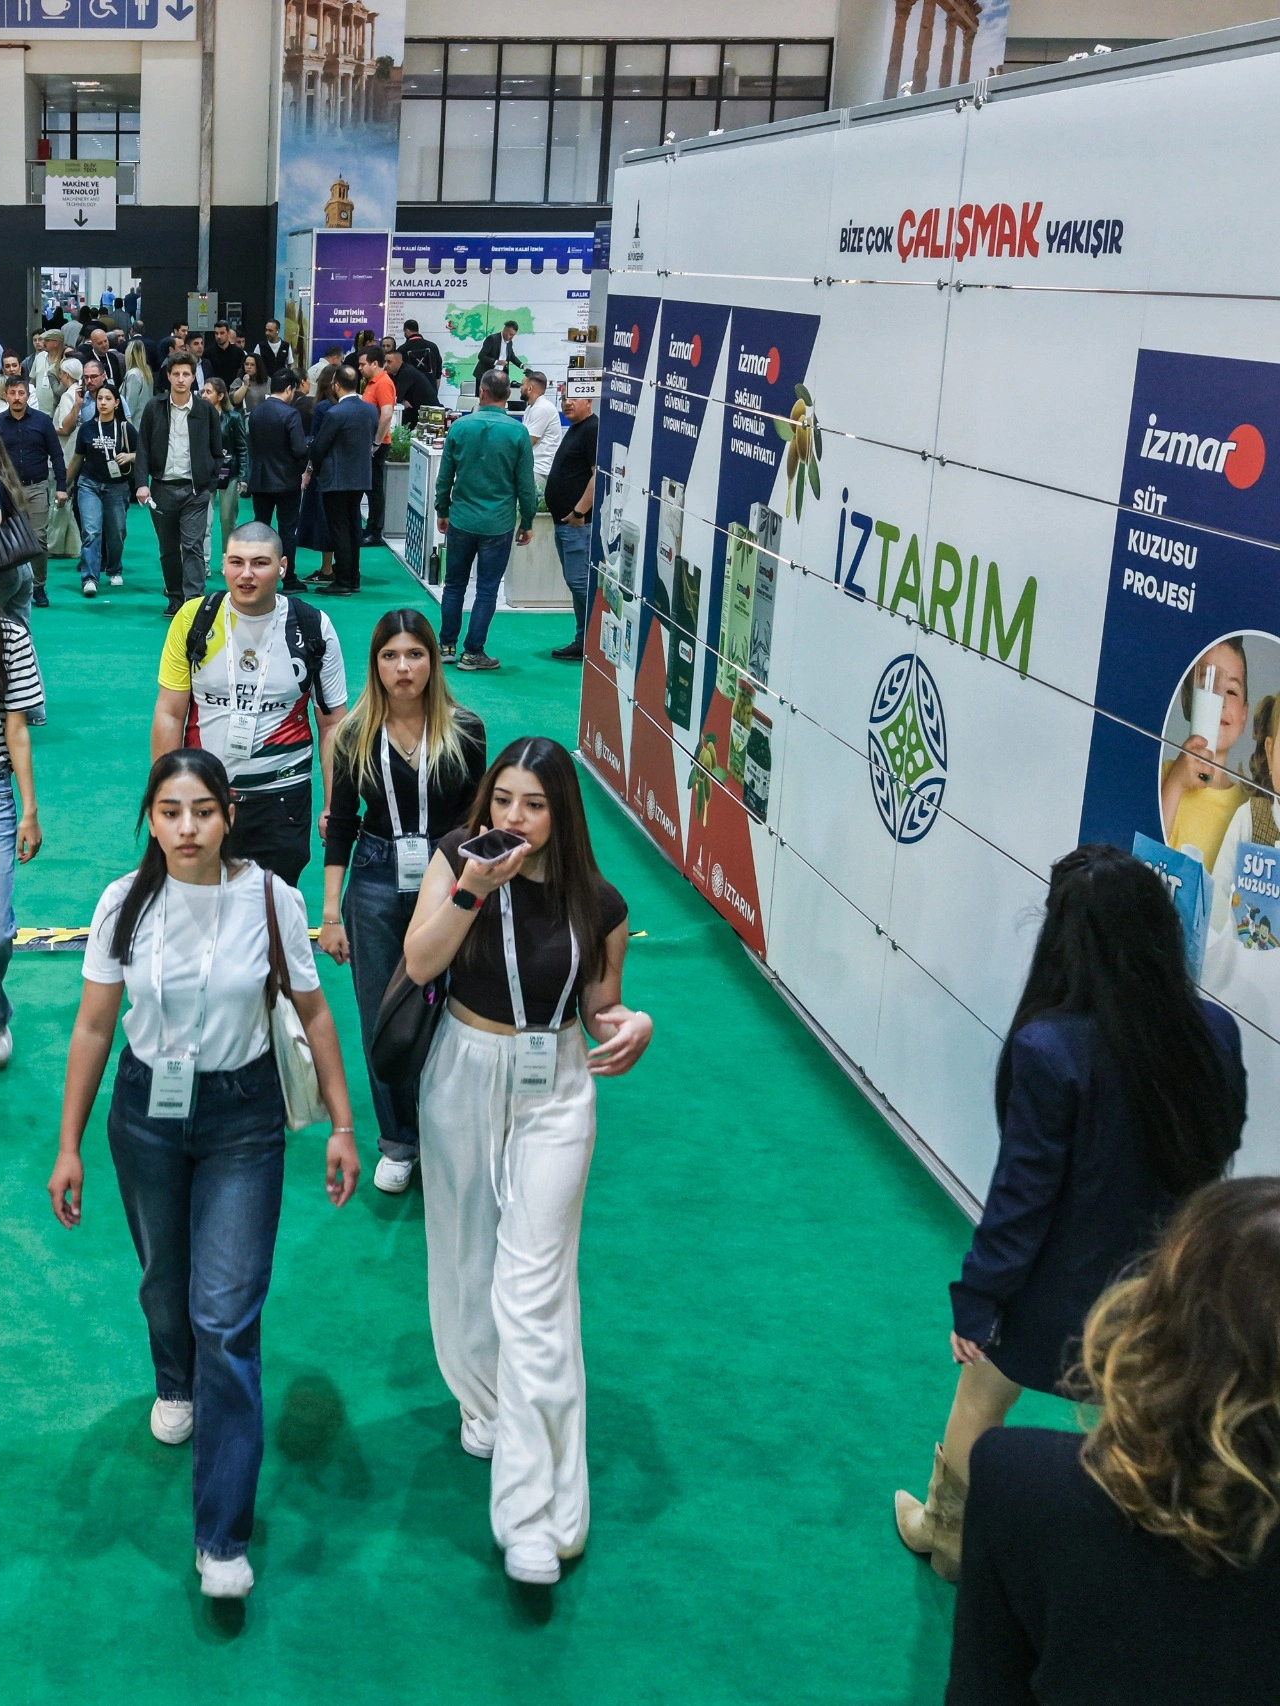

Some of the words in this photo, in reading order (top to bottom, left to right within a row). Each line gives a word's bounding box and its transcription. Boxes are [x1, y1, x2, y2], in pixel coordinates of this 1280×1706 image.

[62, 188, 99, 196] TEKNOLOJİ
[839, 220, 864, 253] BİZE
[865, 226, 894, 255] ÇOK
[897, 201, 1043, 263] ÇALIŞMAK
[1046, 219, 1124, 258] YAKIŞIR
[389, 279, 442, 287] KAMLARLA
[444, 279, 468, 287] 2025
[329, 316, 349, 324] KALBİ
[350, 316, 368, 324] İZMİR
[333, 308, 364, 316] ÜRETİMİN
[613, 324, 634, 348] izmar
[668, 333, 694, 360] izmar
[738, 344, 771, 377] izmar
[665, 371, 688, 390] SAĞLIKLI
[664, 393, 690, 413] GÜVENİLİR
[734, 388, 762, 409] SAĞLIKLI
[663, 416, 681, 433] UYGUN
[680, 419, 698, 439] FİYATLI
[732, 412, 765, 437] GÜVENİLİR
[731, 437, 752, 458] UYGUN
[753, 442, 776, 466] FİYATLI
[1140, 413, 1237, 473] izmar
[1132, 485, 1167, 515] SÜT
[1127, 528, 1197, 570] KUZUSU
[834, 487, 1037, 680] İZTARIM
[1123, 568, 1196, 613] PROJESİ
[236, 684, 258, 696] FLY
[602, 740, 621, 774] İZTARIM
[654, 801, 677, 841] İZTARIM
[1243, 852, 1276, 880] SÜT
[1237, 875, 1280, 899] KUZUSU
[724, 877, 756, 926] İZTARIM
